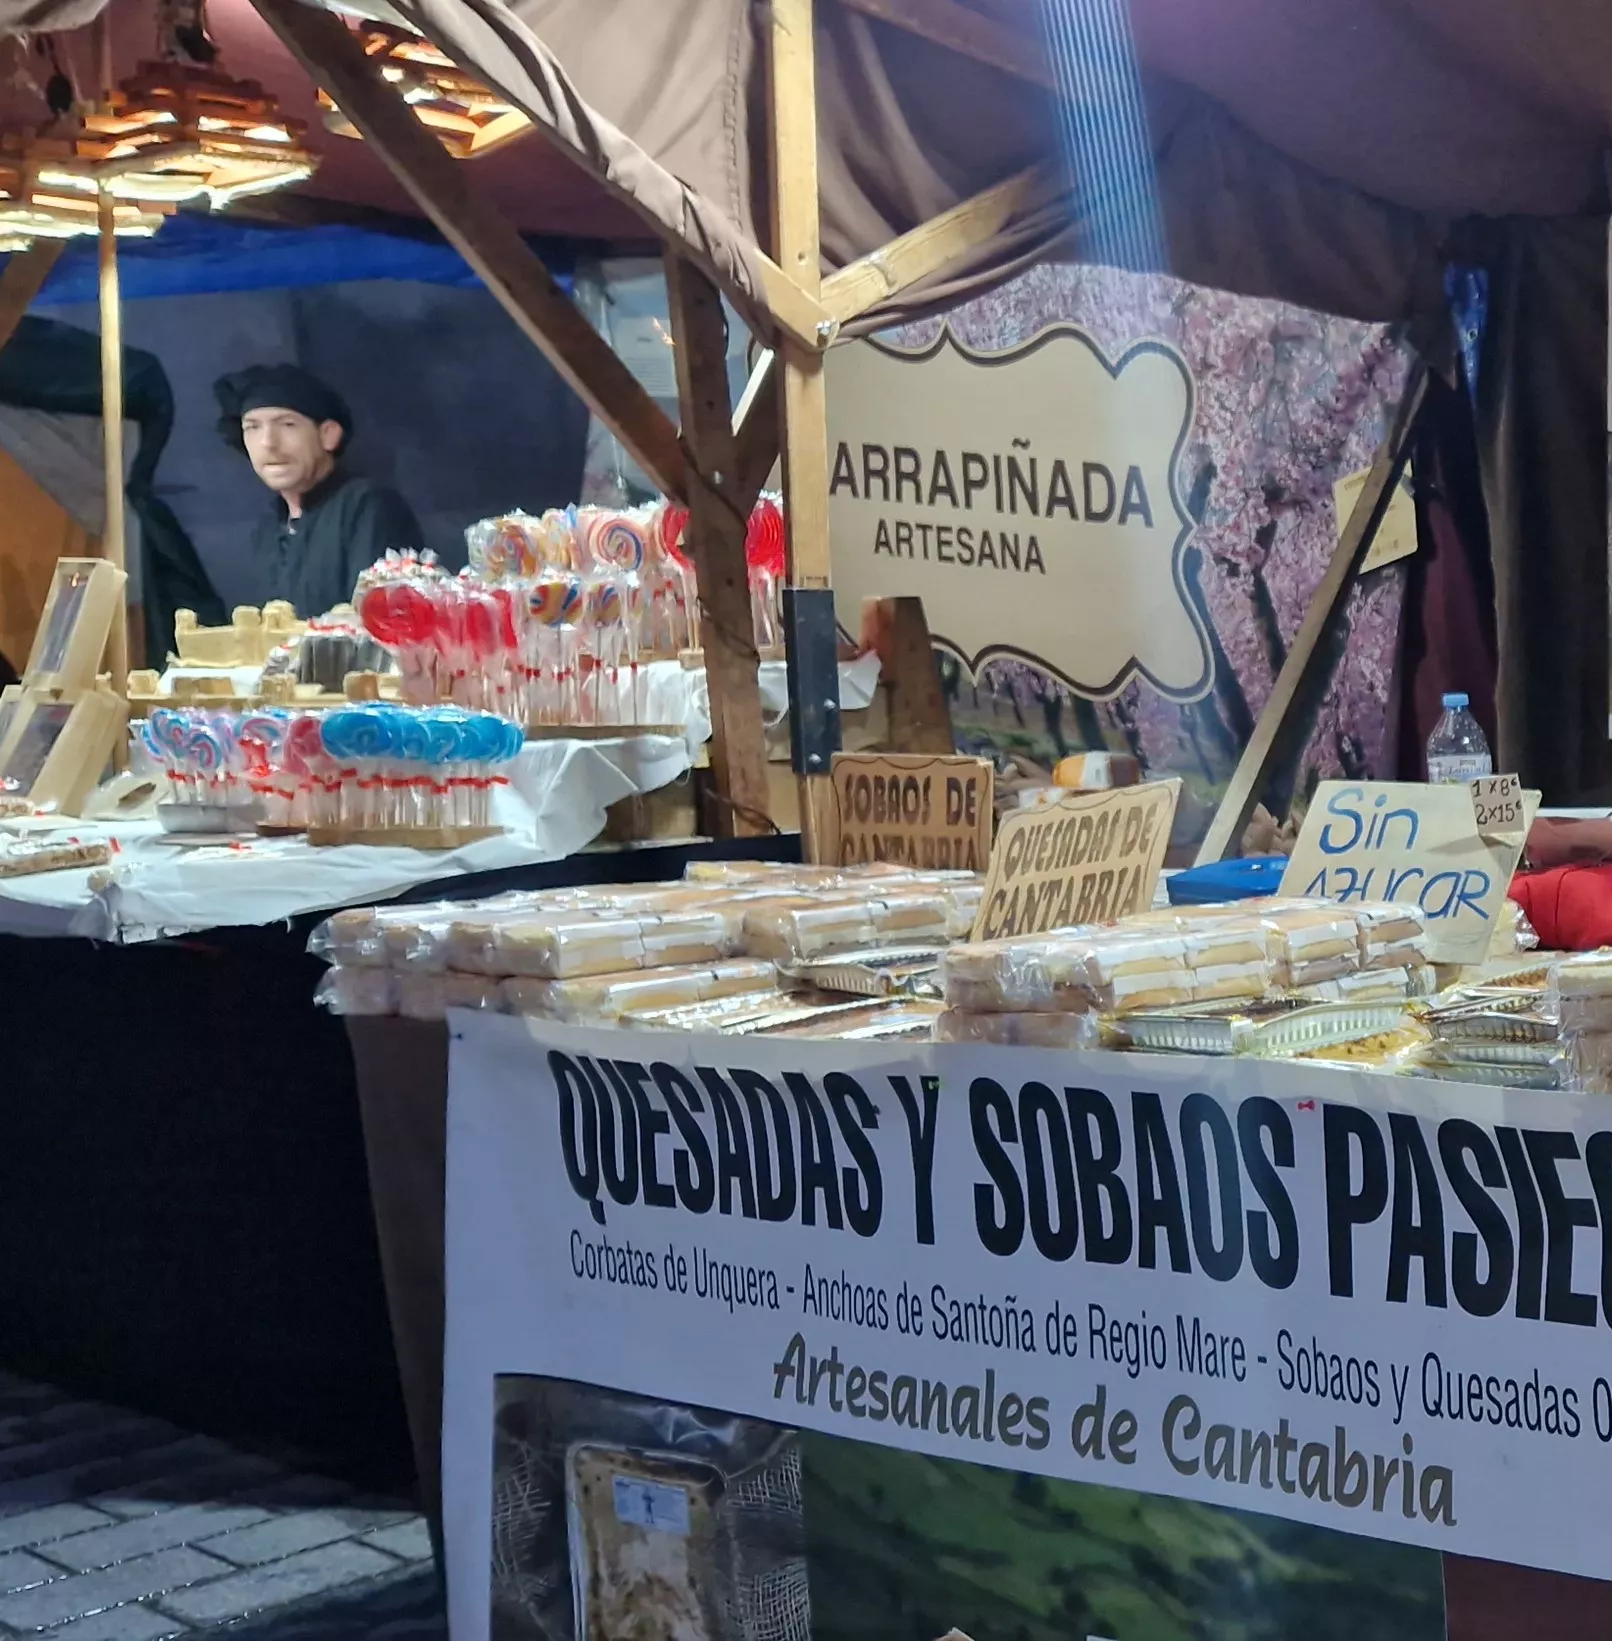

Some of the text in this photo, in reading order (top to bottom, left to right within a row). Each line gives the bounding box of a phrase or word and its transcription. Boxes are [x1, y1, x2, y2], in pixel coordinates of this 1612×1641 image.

[828, 436, 1155, 530] ARRAPIÑADA
[873, 517, 1047, 576] ARTESANA
[843, 772, 978, 828] SOBAOS DE
[1004, 800, 1160, 882] QUESADAS DE
[1318, 786, 1420, 855] Sin
[982, 864, 1143, 941] CANTABRIA
[546, 1049, 884, 1238] QUESADAS
[888, 1074, 940, 1245] Y
[968, 1076, 1300, 1291] SOBAOS
[569, 1228, 658, 1290] Corbatas
[663, 1243, 688, 1294] de
[692, 1246, 780, 1315] Unquera
[803, 1263, 889, 1332] Anchoas
[896, 1280, 924, 1338] de
[930, 1283, 1037, 1353] Santoña
[1045, 1299, 1079, 1359] de
[1087, 1302, 1168, 1380] Regio
[1175, 1314, 1247, 1383] Mare
[1276, 1328, 1381, 1408] Sobaos
[1390, 1363, 1410, 1426] y
[1421, 1351, 1582, 1439] Quesadas
[772, 1331, 1458, 1528] Artesanales de Cantabria
